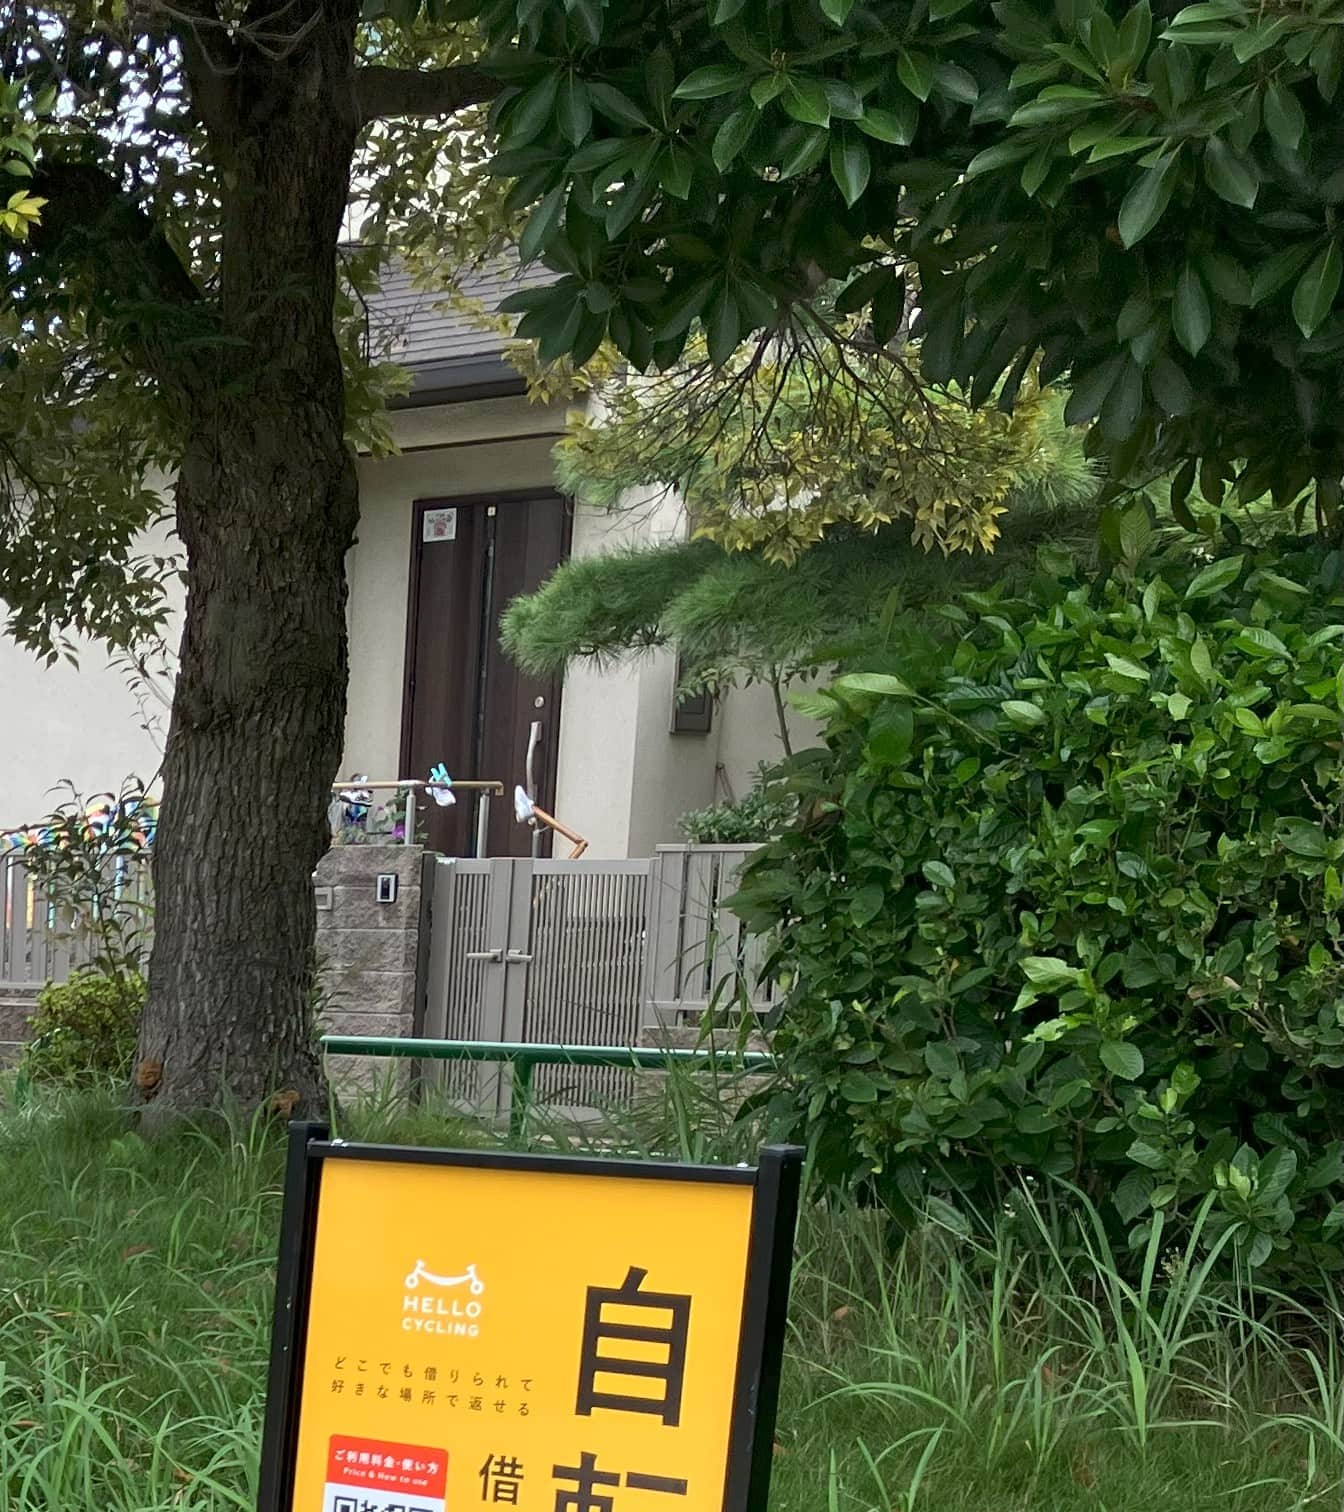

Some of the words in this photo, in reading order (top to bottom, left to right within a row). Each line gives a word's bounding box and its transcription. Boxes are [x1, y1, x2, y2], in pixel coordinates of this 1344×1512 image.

[402, 1295, 482, 1319] HELLO
[401, 1317, 480, 1338] CYCLING
[334, 1356, 534, 1393] どこでも借りられて
[330, 1379, 531, 1417] 好きな場所で返せる
